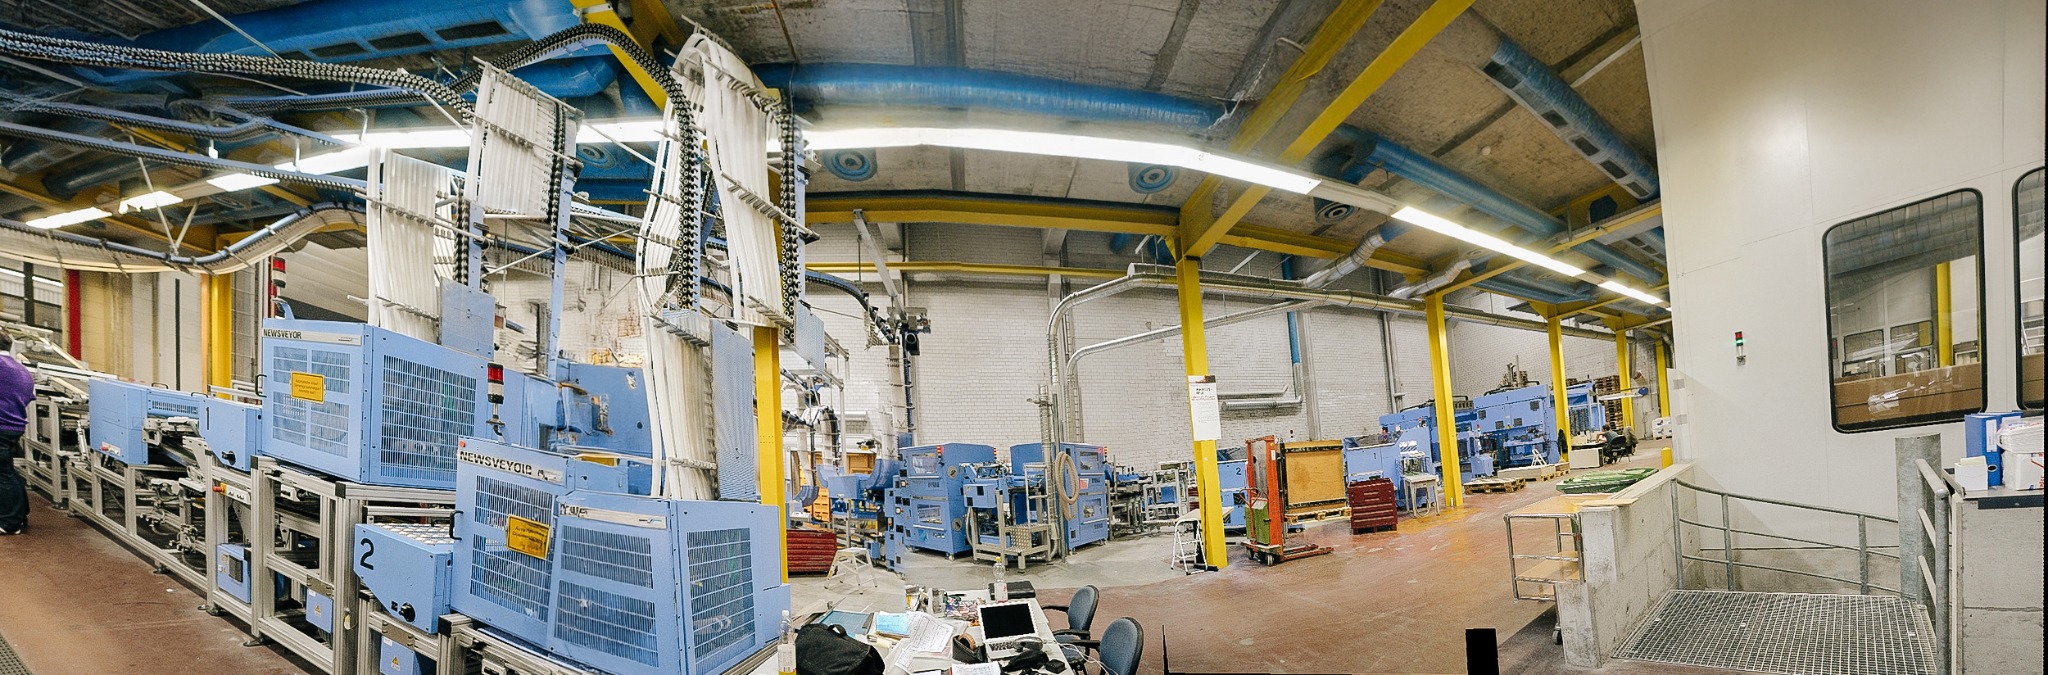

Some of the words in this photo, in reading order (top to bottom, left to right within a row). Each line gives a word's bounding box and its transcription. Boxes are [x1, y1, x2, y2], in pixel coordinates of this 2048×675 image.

[263, 328, 303, 340] NEWSVEYOR
[206, 406, 210, 431] 1
[1235, 467, 1242, 476] 2
[360, 537, 375, 571] 2
